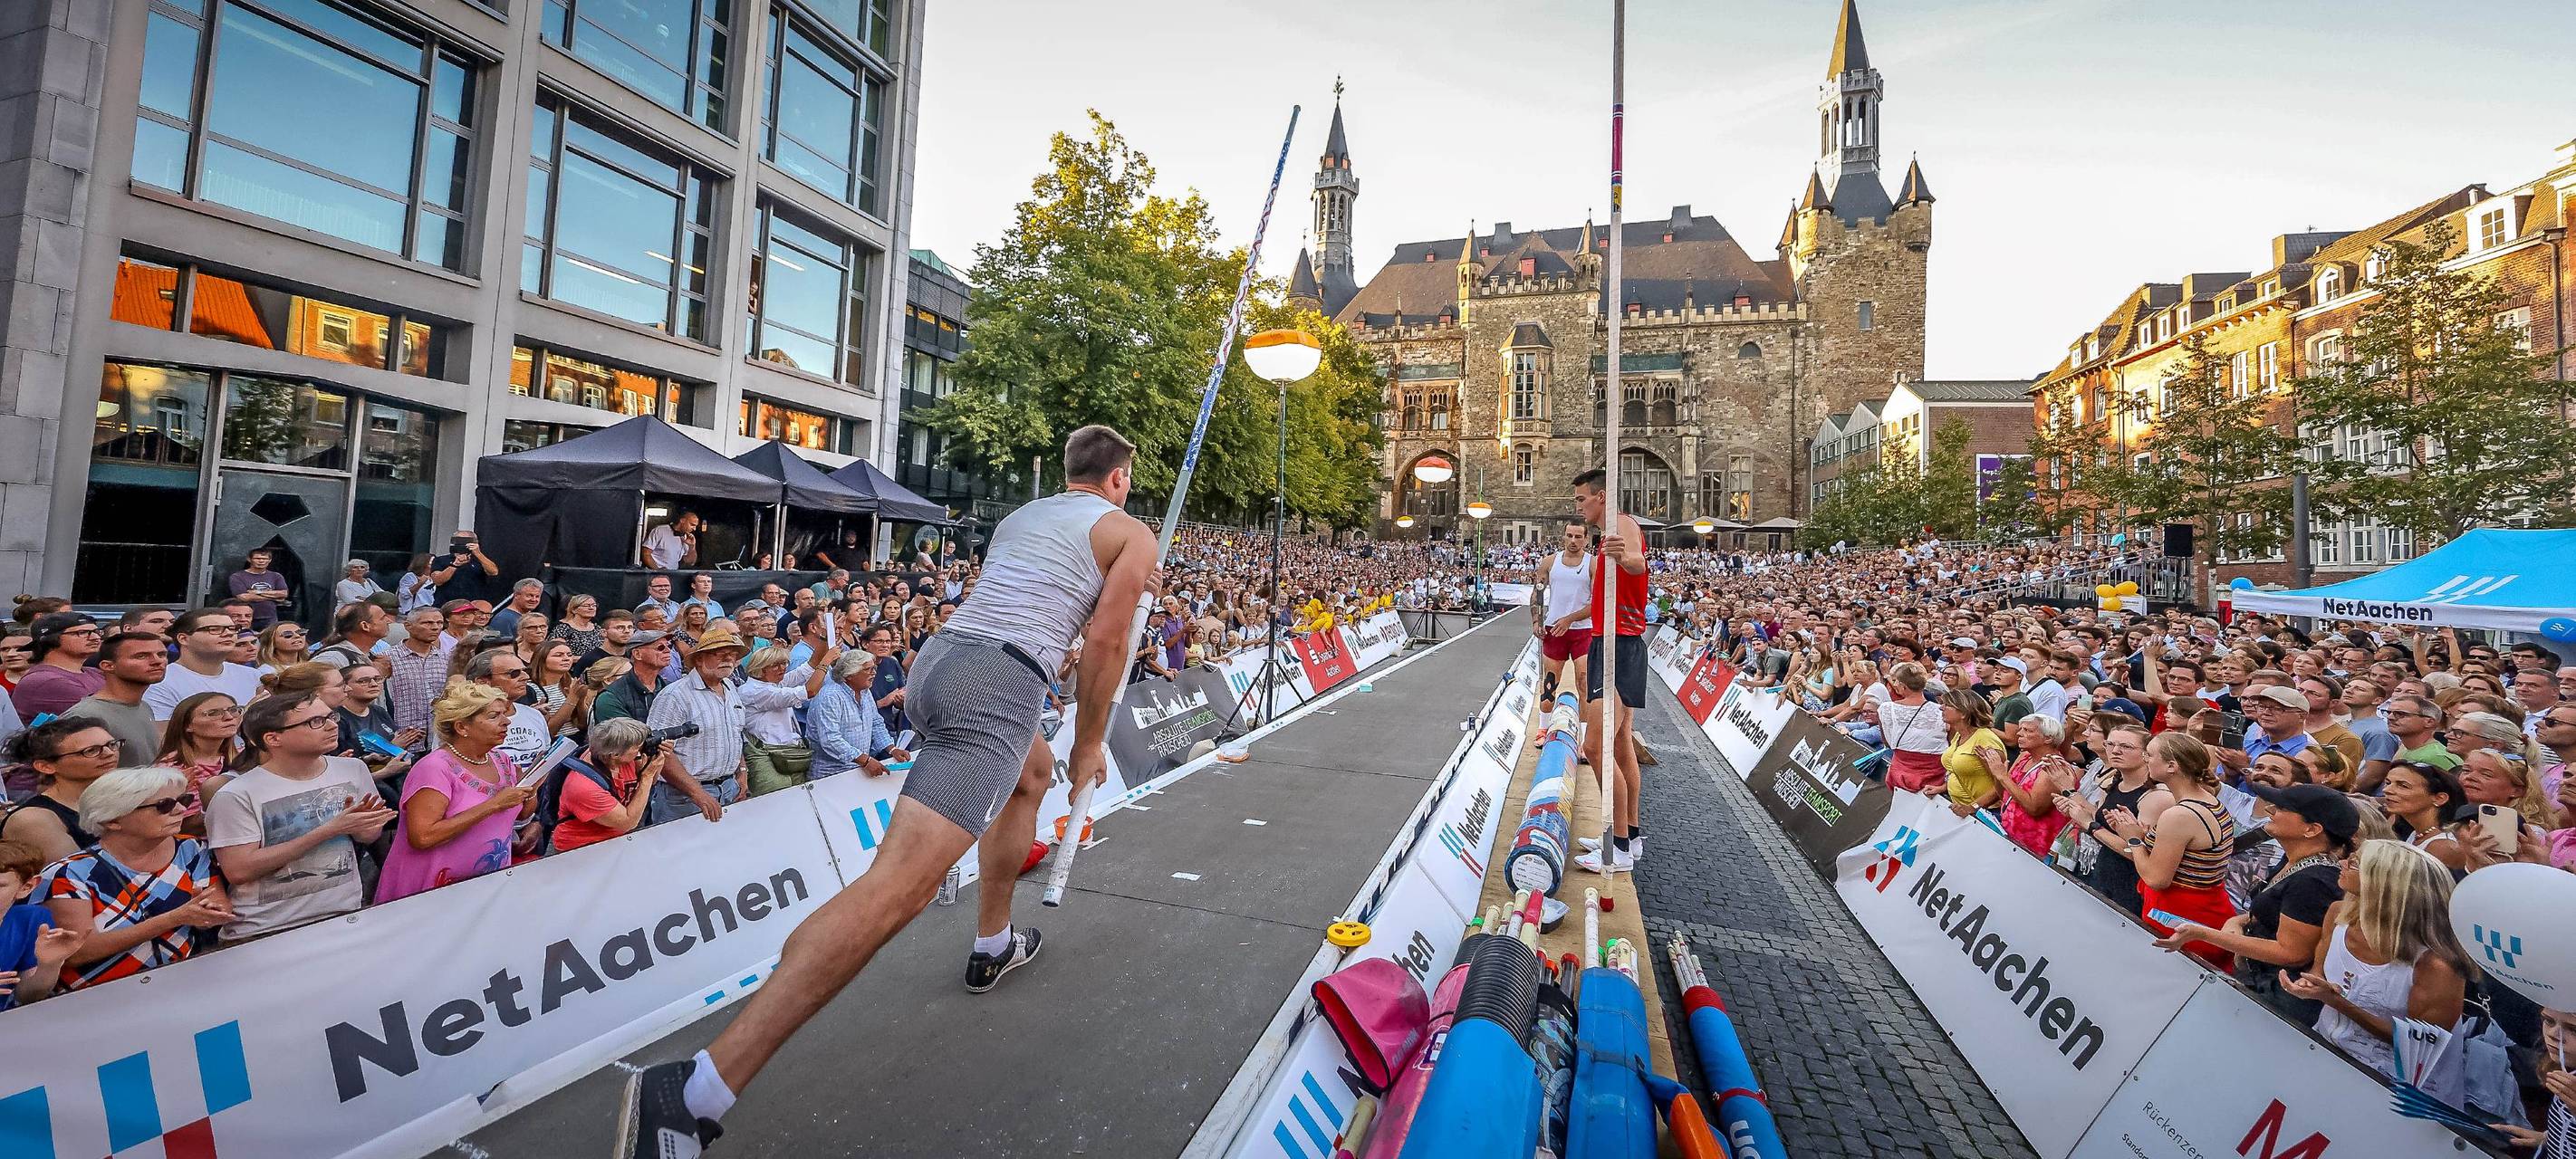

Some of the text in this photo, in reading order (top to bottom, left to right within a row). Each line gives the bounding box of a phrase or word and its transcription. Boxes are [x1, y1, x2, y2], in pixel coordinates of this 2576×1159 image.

[2322, 598, 2433, 621] NetAachen
[1157, 734, 1192, 758] RAUSCHEID
[1727, 702, 1769, 750] NetAachen
[1457, 787, 1493, 849] NetAachen
[1773, 779, 1802, 809] RAUSCHEID
[325, 867, 810, 1103] NetAachen
[1908, 862, 2104, 1071] NetAachen
